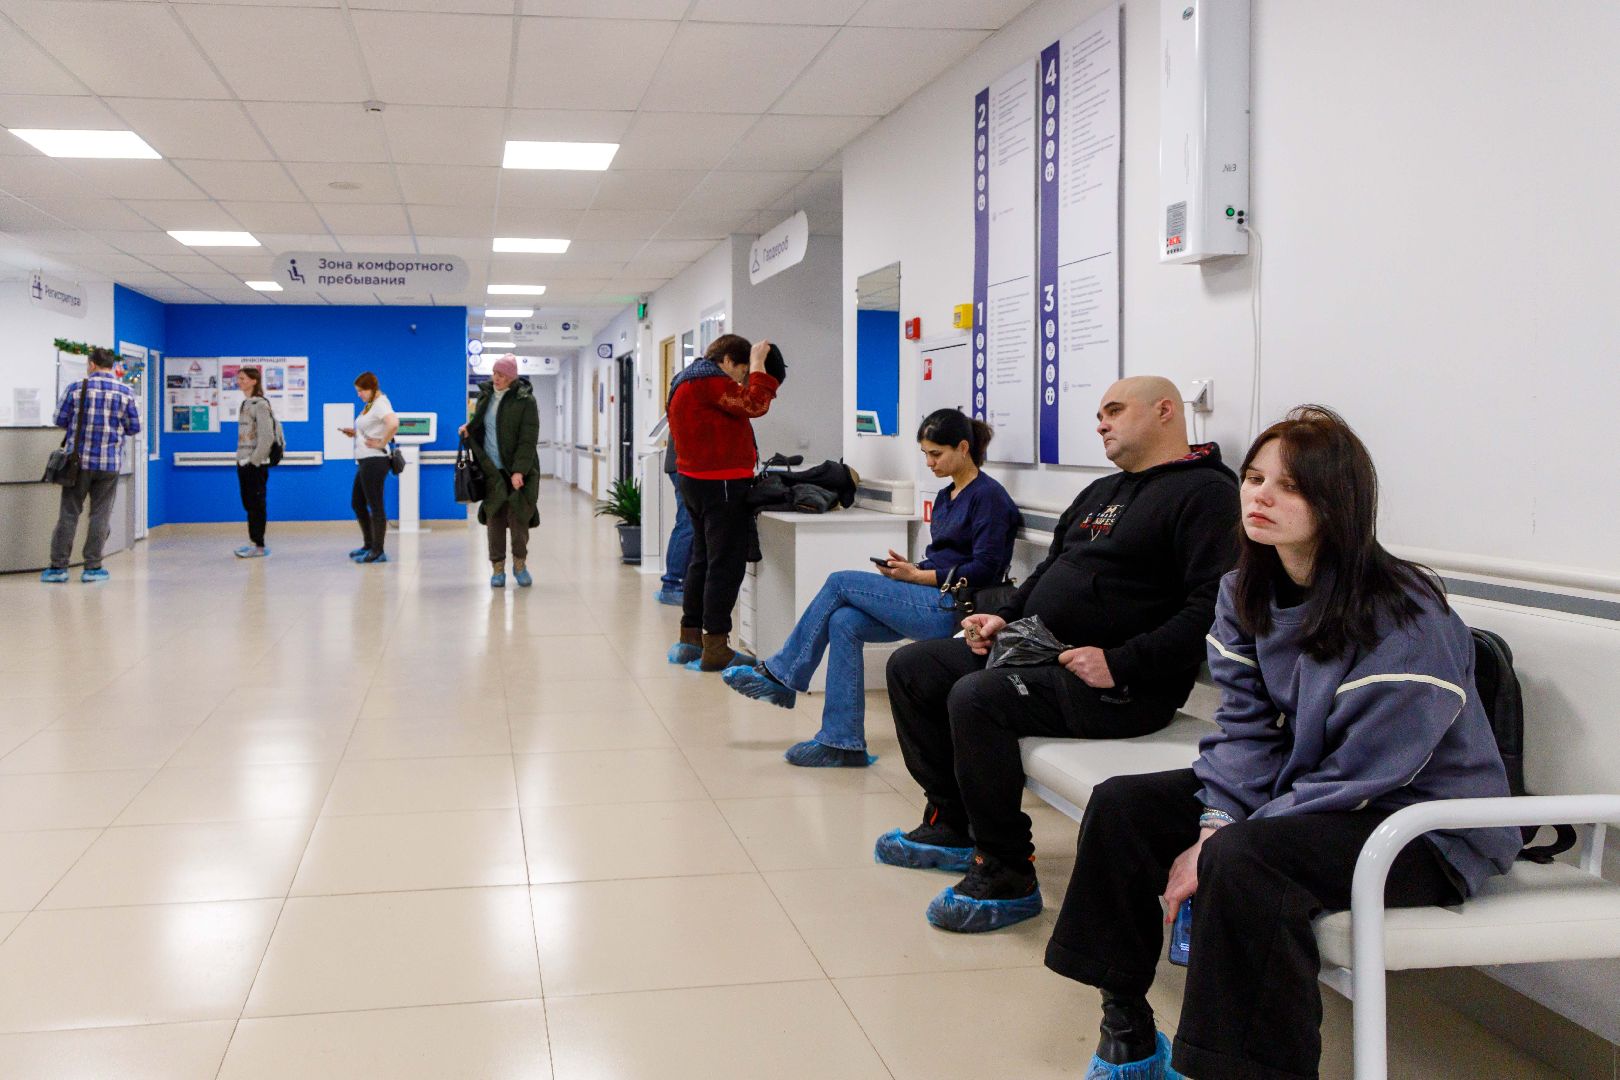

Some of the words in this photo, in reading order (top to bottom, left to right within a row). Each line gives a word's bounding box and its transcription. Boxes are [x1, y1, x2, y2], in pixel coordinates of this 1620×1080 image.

[1045, 58, 1057, 87] 4
[977, 103, 986, 130] 2
[318, 257, 353, 270] Зона
[357, 259, 455, 273] комфортного
[318, 273, 406, 286] пребывания
[1043, 284, 1055, 313] 3
[977, 301, 984, 326] 1
